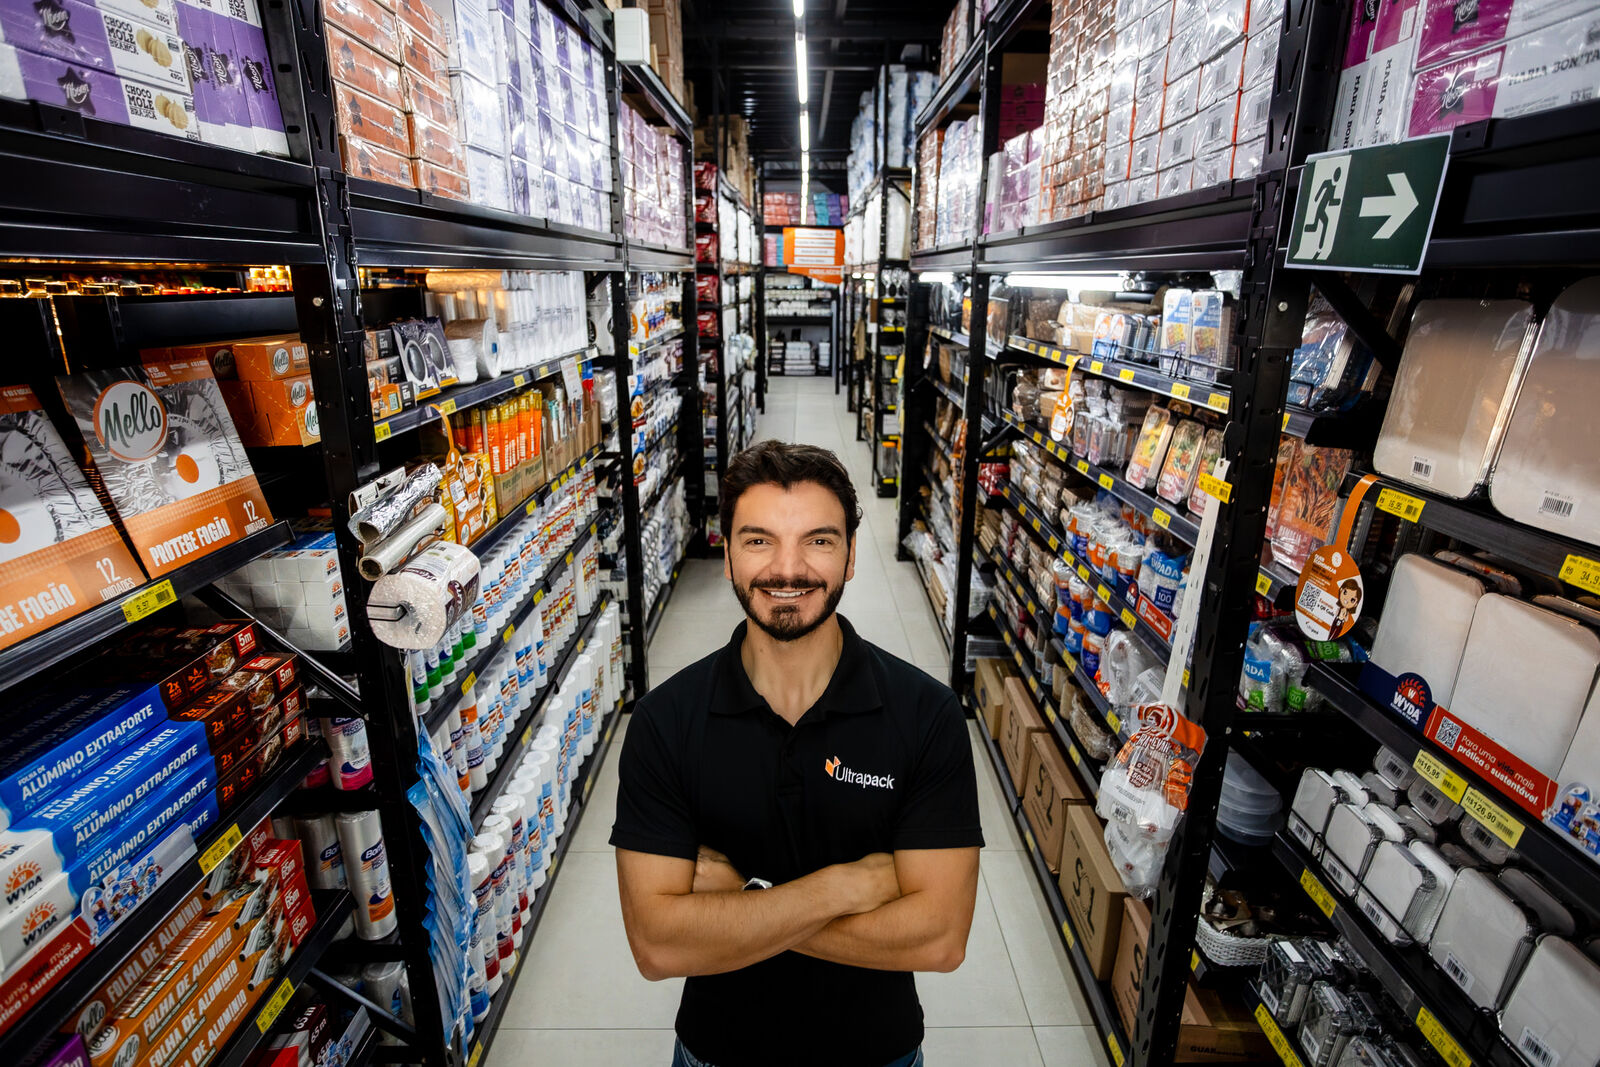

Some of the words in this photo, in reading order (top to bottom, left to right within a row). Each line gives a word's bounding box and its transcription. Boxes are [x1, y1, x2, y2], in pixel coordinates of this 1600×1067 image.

[104, 15, 133, 33] CHOCO
[107, 26, 137, 45] MOLE
[125, 84, 152, 99] CHOCO
[127, 94, 155, 111] MOLE
[1349, 75, 1361, 117] MARIA
[1342, 120, 1353, 149] BONI
[103, 391, 162, 450] Mello
[243, 500, 258, 522] 12
[244, 518, 268, 536] UNIDADES
[149, 531, 199, 567] PROTEGE
[195, 516, 231, 547] FOGÃO
[96, 557, 121, 585] 12
[99, 577, 136, 601] UNIDADES
[1158, 591, 1172, 603] 100
[18, 582, 77, 624] FOGÃO
[238, 631, 253, 647] 5m
[167, 679, 180, 694] 2x
[279, 667, 293, 682] 5m
[286, 696, 299, 711] 5m
[1393, 691, 1420, 721] WYDA
[212, 719, 225, 733] 2x
[286, 725, 299, 741] 5m
[22, 750, 85, 801] ALUMÍNIO
[85, 704, 154, 757] EXTRAFORTE
[221, 752, 233, 767] 2x
[1461, 735, 1479, 752] Para
[1478, 748, 1497, 764] uma
[1497, 760, 1515, 776] vida
[1514, 772, 1536, 791] mais
[42, 776, 110, 820] ALUMÍNIO
[104, 728, 179, 776] EXTRAFORTE
[835, 765, 895, 790] Ultrapack
[1456, 745, 1485, 767] prática
[1484, 763, 1491, 771] e
[1490, 767, 1539, 806] sustentável
[76, 794, 135, 847] ALUMÍNIO
[135, 744, 198, 800] EXTRAFORTE
[222, 784, 235, 799] 2x
[89, 830, 146, 885] ALUMÍNIO
[146, 777, 208, 836] EXTRAFORTE
[251, 831, 267, 852] 65m
[281, 858, 296, 880] 65m
[6, 875, 43, 906] WYDA
[284, 888, 300, 909] 65m
[23, 916, 58, 947] WYDA
[292, 915, 308, 937] 65m
[49, 942, 72, 965] mais
[29, 942, 83, 996] sustentável
[106, 959, 144, 1003] FOLHA
[141, 942, 161, 965] DE
[142, 993, 177, 1037] FOLHA
[175, 974, 191, 1000] DE
[181, 1007, 198, 1034] DE
[191, 1039, 210, 1065] DE
